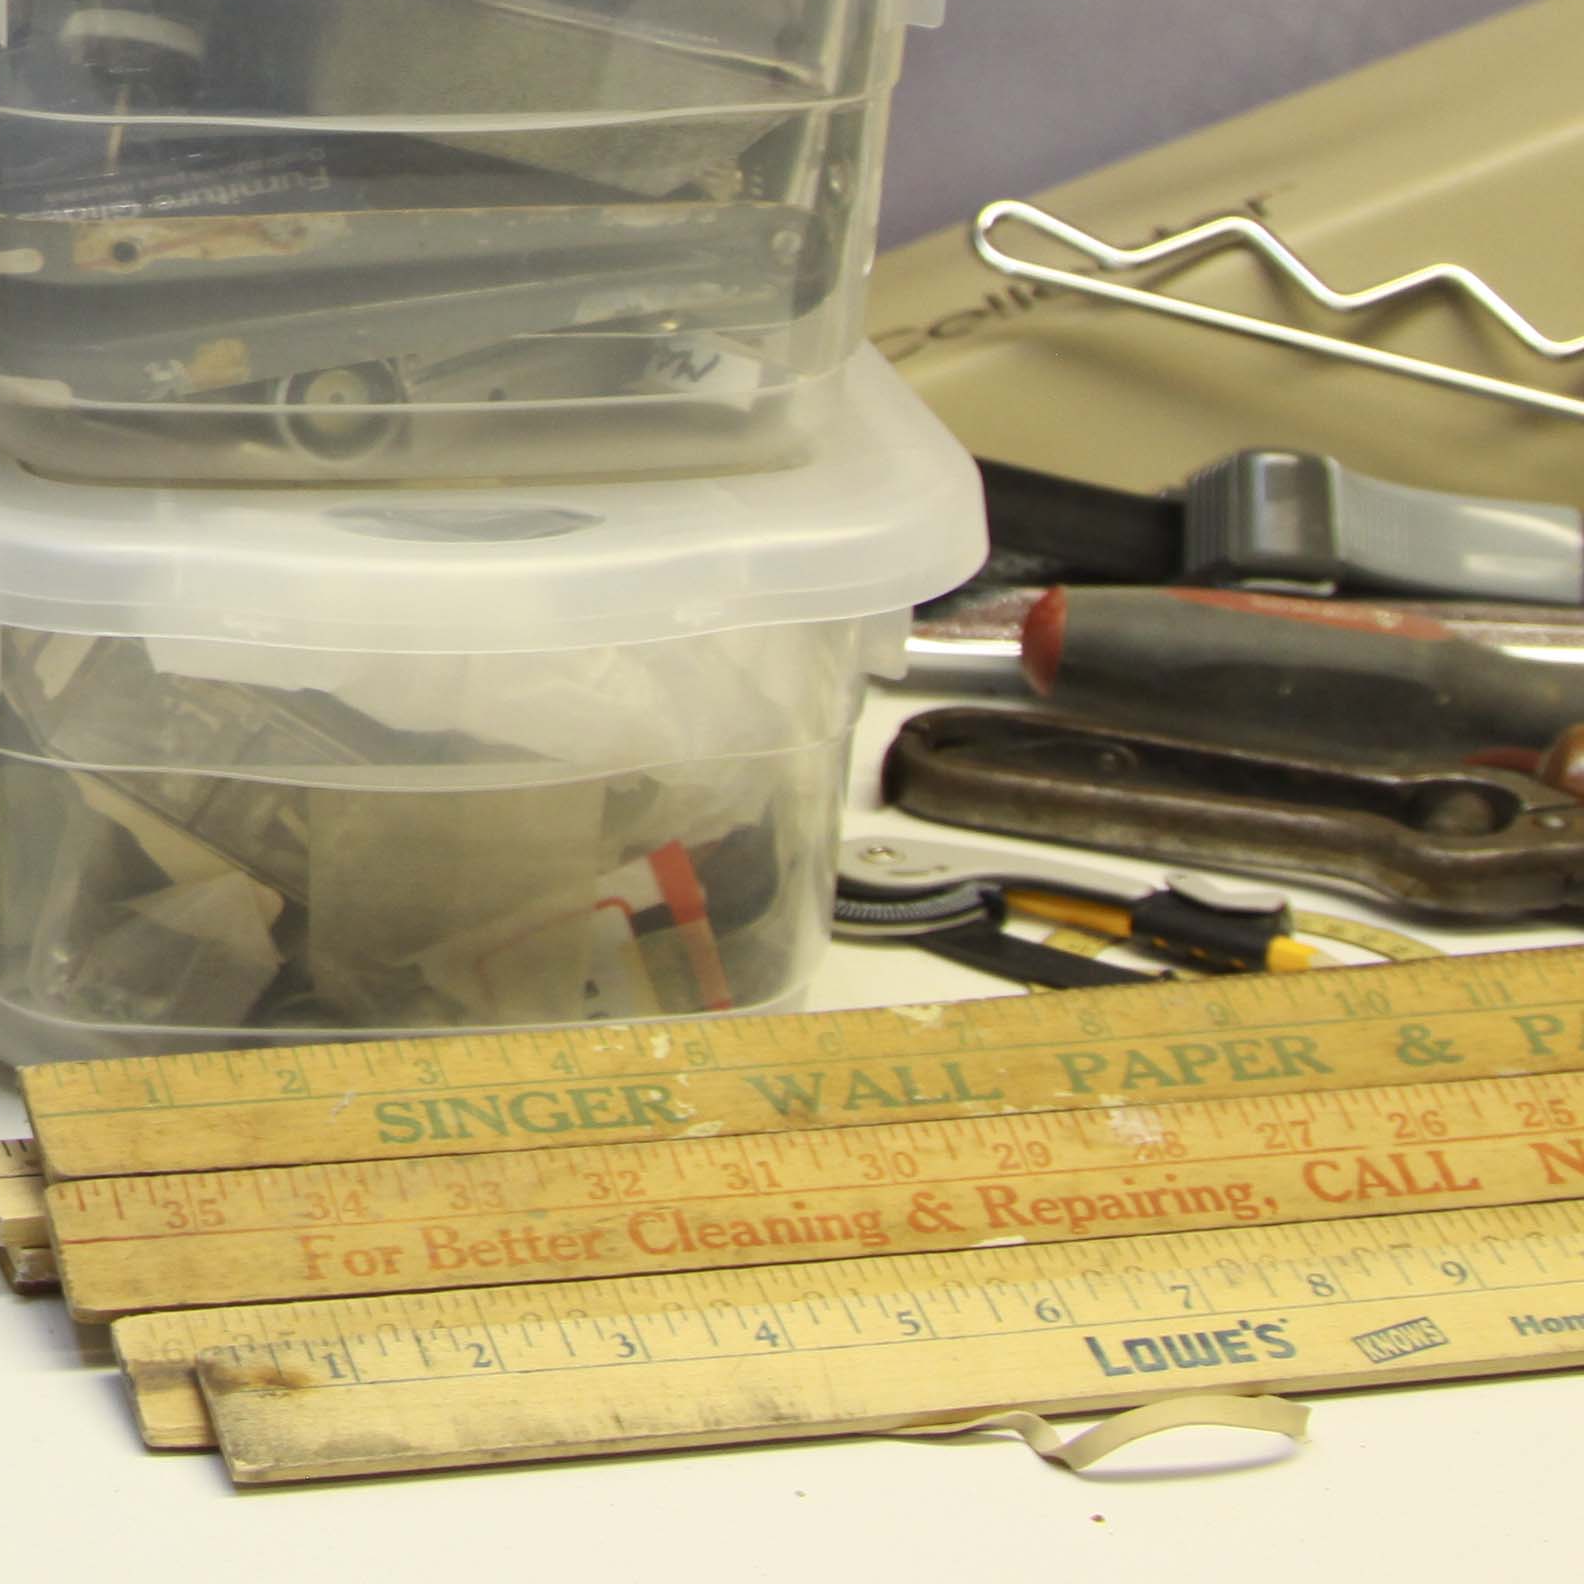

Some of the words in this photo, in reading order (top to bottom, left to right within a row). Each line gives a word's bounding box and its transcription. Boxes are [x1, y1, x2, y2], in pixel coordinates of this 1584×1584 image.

[141, 1078, 160, 1103] 1
[277, 1069, 306, 1095] 2
[412, 1057, 439, 1085] 3
[550, 1051, 576, 1076] 4
[684, 1040, 710, 1067] 5
[376, 1083, 692, 1145] SINGER
[743, 1060, 1004, 1121] WALL
[1056, 1035, 1334, 1096] PAPER
[1395, 1023, 1464, 1067] &
[1513, 1012, 1584, 1056] P
[298, 1233, 405, 1281] For
[420, 1224, 607, 1272] Better
[627, 1201, 891, 1256] Cleaning
[907, 1184, 967, 1235] &
[975, 1173, 1279, 1235] Repairing,
[1302, 1150, 1483, 1203] CALL
[322, 1352, 347, 1380] 1
[467, 1343, 493, 1368] 2
[613, 1333, 638, 1358] 3
[753, 1320, 780, 1348] 4
[895, 1310, 922, 1337] 5
[1035, 1297, 1062, 1323] 6
[1169, 1284, 1194, 1310] 7
[1307, 1272, 1337, 1298] 8
[1441, 1260, 1468, 1286] 9
[1358, 1318, 1445, 1361] KNOWS
